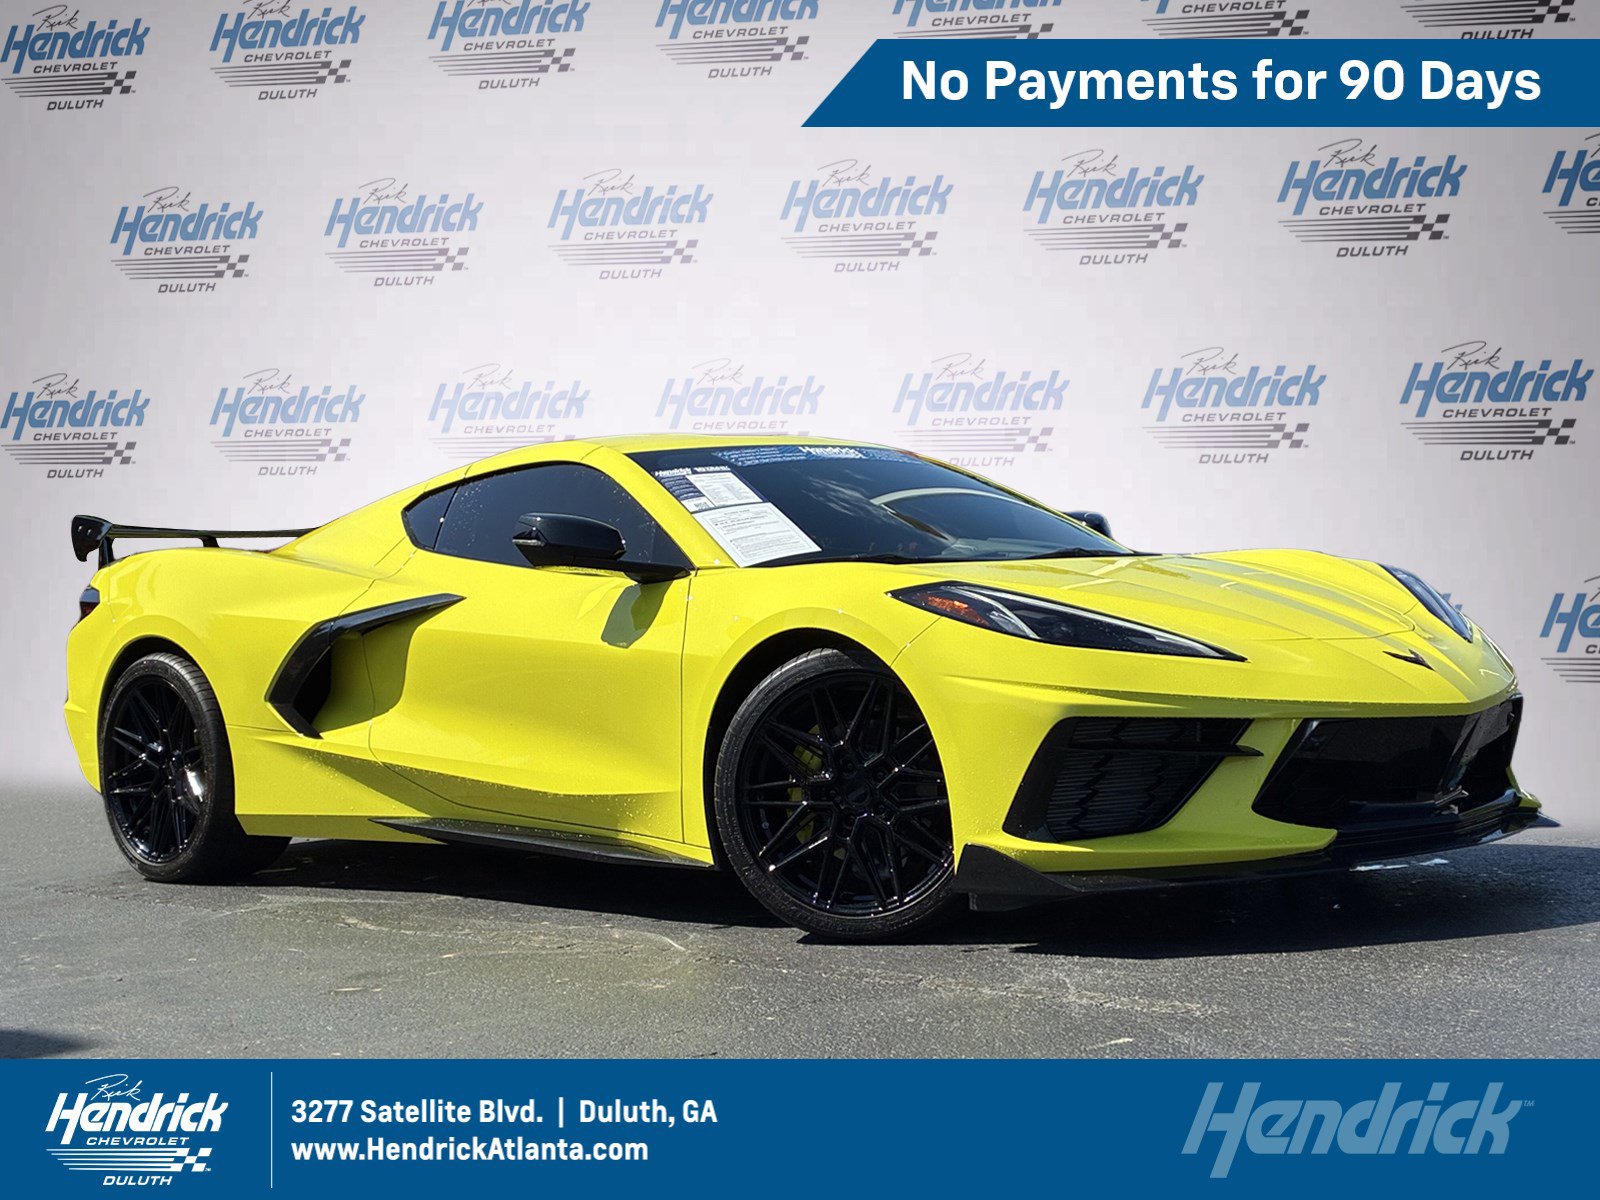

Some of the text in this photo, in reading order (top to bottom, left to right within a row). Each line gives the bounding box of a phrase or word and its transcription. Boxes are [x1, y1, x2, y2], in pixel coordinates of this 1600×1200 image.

[1182, 0, 1286, 13] CHEVROLET
[931, 13, 1031, 26] CHEVROLET
[428, 0, 590, 51] Hendrick
[209, 6, 365, 63] Hendrick
[692, 26, 788, 39] CHEVROLET
[0, 18, 150, 74] Hendrick
[464, 39, 555, 50] CHEVROLET
[244, 51, 331, 62] CHEVROLET
[33, 62, 118, 74] CHEVROLET
[708, 66, 772, 78] DULUTH
[478, 78, 540, 90] DULUTH
[258, 89, 317, 100] DULUTH
[47, 99, 103, 110] DULUTH
[1277, 155, 1468, 215] Hendrick
[1022, 165, 1205, 224] Hendrick
[780, 175, 954, 232] Hendrick
[1319, 203, 1426, 215] CHEVROLET
[547, 183, 714, 240] Hendrick
[324, 193, 484, 248] Hendrick
[1063, 213, 1165, 224] CHEVROLET
[110, 202, 264, 255] Hendrick
[818, 221, 916, 232] CHEVROLET
[584, 229, 678, 240] CHEVROLET
[359, 237, 449, 248] CHEVROLET
[144, 245, 230, 255] CHEVROLET
[1336, 246, 1408, 257] DULUTH
[1079, 253, 1148, 265] DULUTH
[834, 261, 900, 272] DULUTH
[599, 268, 662, 279] DULUTH
[373, 276, 434, 286] DULUTH
[158, 283, 216, 293] DULUTH
[1141, 364, 1327, 421] Hendrick
[1400, 359, 1594, 417] Hendrick
[655, 375, 825, 429] Hendrick
[892, 370, 1070, 426] Hendrick
[209, 385, 366, 437] Hendrick
[427, 380, 590, 433] Hendrick
[0, 389, 150, 440] Hendrick
[1182, 412, 1286, 421] CHEVROLET
[1442, 407, 1552, 418] CHEVROLET
[693, 421, 788, 429] CHEVROLET
[932, 417, 1031, 426] CHEVROLET
[244, 428, 331, 437] CHEVROLET
[464, 424, 555, 433] CHEVROLET
[33, 432, 117, 440] CHEVROLET
[1199, 453, 1268, 463] DULUTH
[1460, 450, 1533, 460] DULUTH
[47, 469, 103, 478] DULUTH
[258, 466, 317, 475] DULUTH
